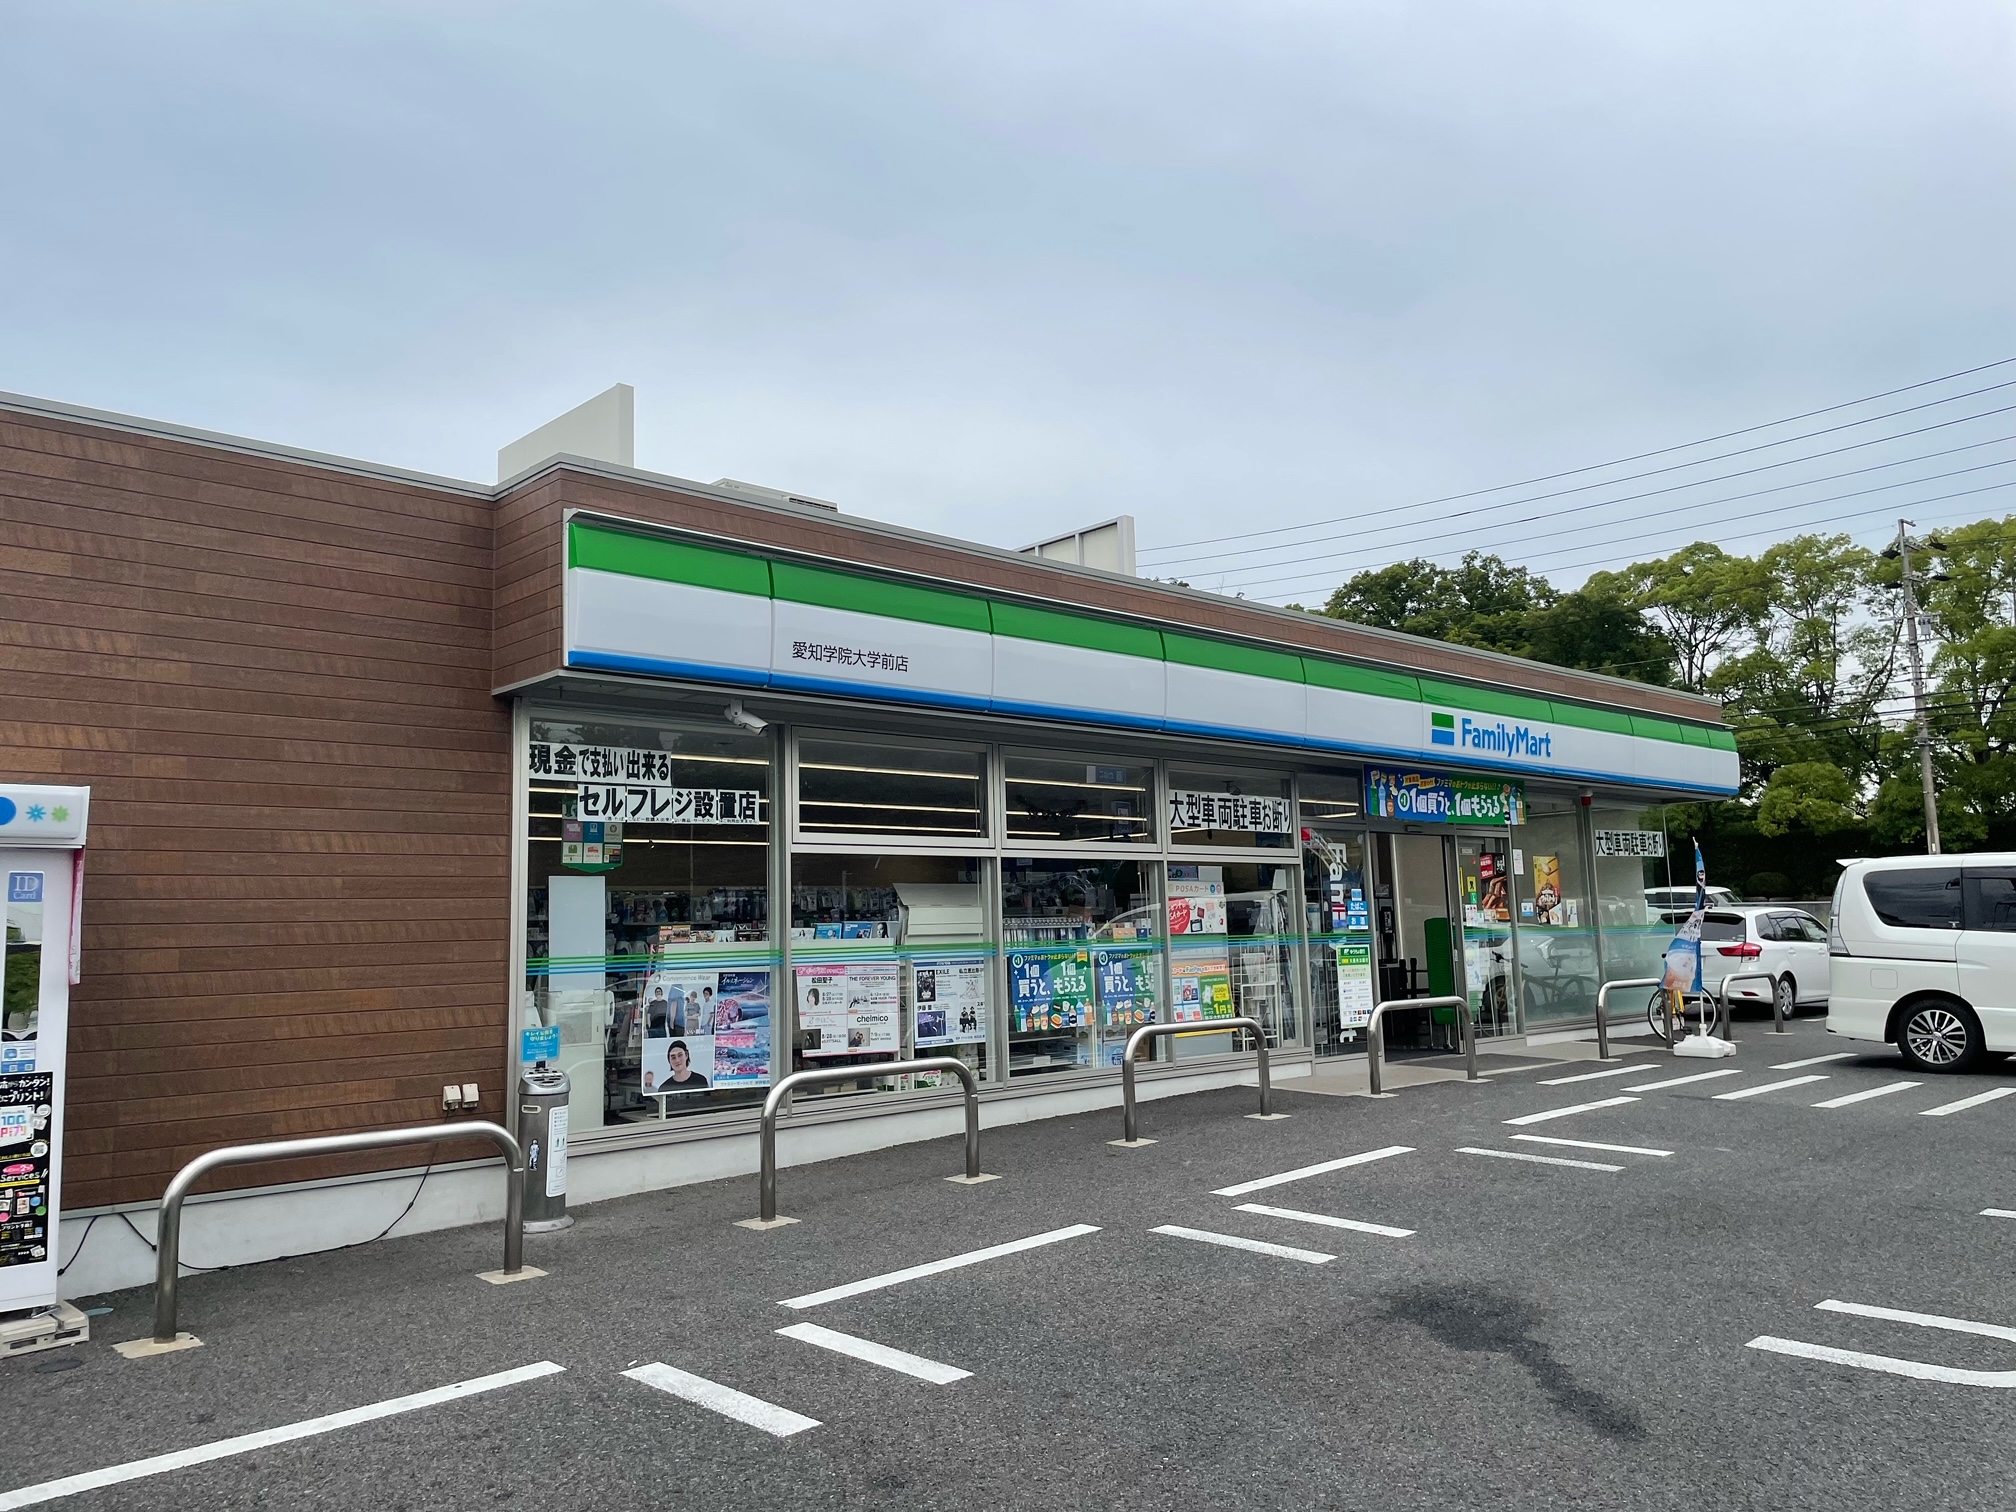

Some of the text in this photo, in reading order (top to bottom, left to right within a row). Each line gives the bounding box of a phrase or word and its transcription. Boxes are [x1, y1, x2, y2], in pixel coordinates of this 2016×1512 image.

[792, 641, 909, 672] 愛知学院大学前店
[1461, 717, 1551, 758] FamilyMart
[529, 744, 669, 781] 現金で支払い出来る
[580, 786, 757, 819] セルフレジ設置店
[1170, 792, 1291, 832] 大型車両駐車お断り
[1596, 831, 1664, 856] 大型車両駐車お断り
[1175, 885, 1209, 893] POSAカード
[1054, 974, 1087, 995] もらえる
[856, 1014, 889, 1023] chelmico
